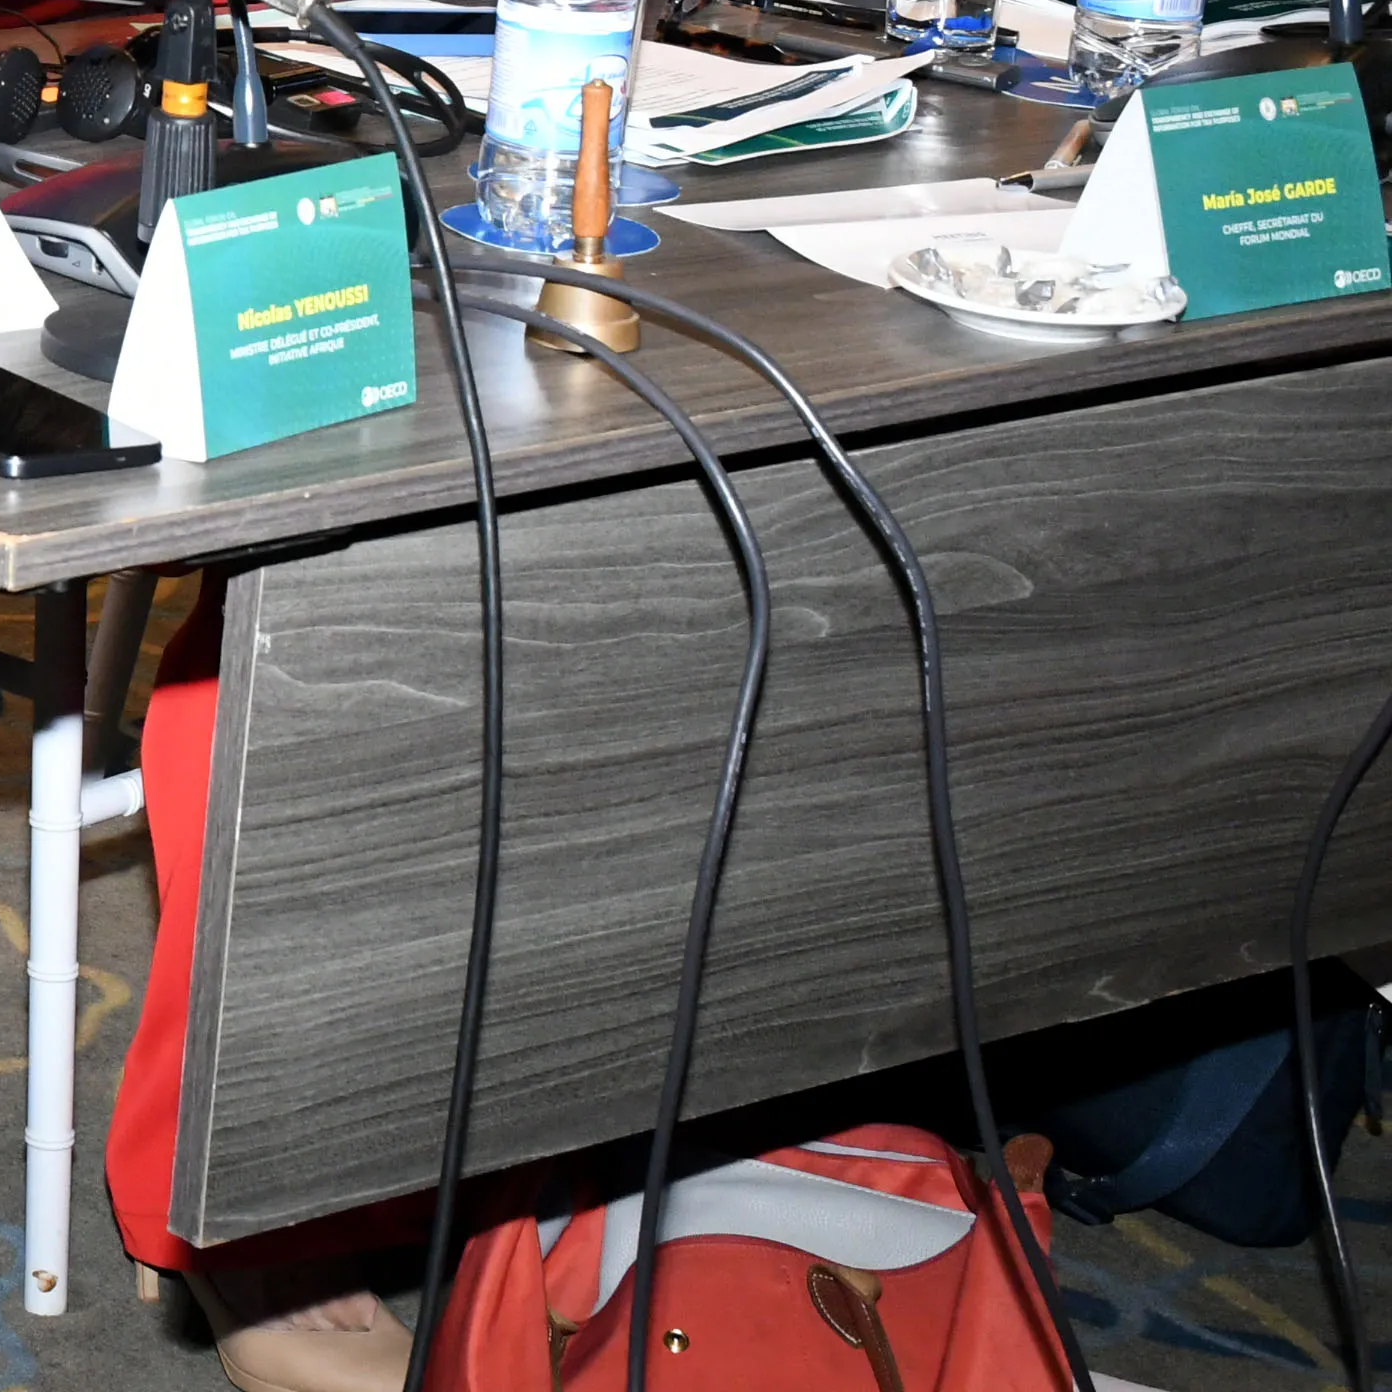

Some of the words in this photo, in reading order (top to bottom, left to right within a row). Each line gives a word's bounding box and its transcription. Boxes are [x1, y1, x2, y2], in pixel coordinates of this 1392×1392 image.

[1202, 190, 1245, 210] María
[1246, 184, 1281, 205] José
[1284, 178, 1337, 200] GARDE
[1311, 212, 1324, 223] DU
[1240, 233, 1270, 246] FORUM
[1271, 228, 1311, 241] MONDIAL
[1352, 268, 1381, 283] OECD
[238, 304, 293, 331] Nicolas
[294, 284, 369, 318] YENOUSSI
[308, 328, 320, 341] ET
[379, 381, 408, 400] OECD
